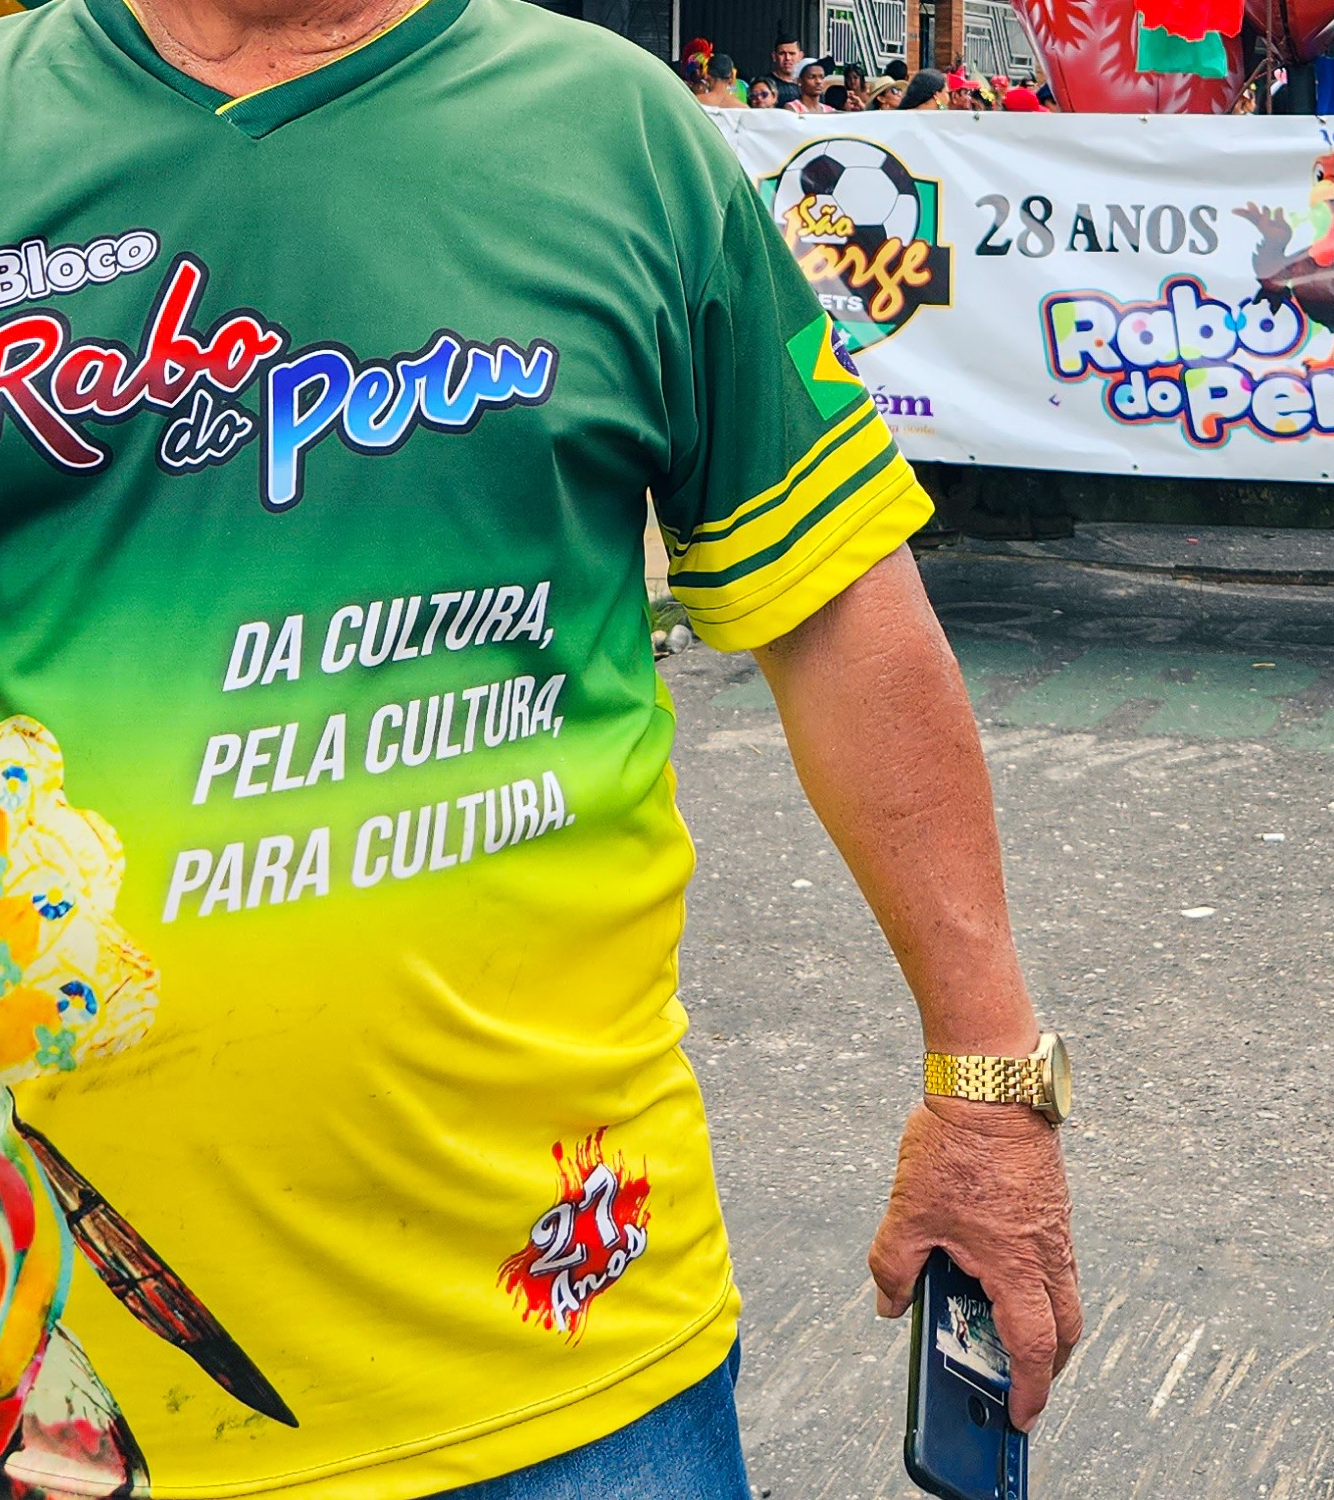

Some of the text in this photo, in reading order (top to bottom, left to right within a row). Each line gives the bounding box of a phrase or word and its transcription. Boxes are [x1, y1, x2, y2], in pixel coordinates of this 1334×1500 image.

[798, 193, 855, 237] São
[974, 193, 1219, 259] 28 ANOS
[820, 292, 863, 312] ETS
[1047, 281, 1302, 375] Rabo
[161, 335, 553, 505] do Peru
[1113, 369, 1182, 417] do
[222, 580, 555, 693] DA CULTURA,
[191, 673, 567, 806] PELA CULTURA,
[160, 769, 577, 924] PARA CULTURA.
[529, 1162, 621, 1277] 27
[550, 1222, 648, 1333] Anos
